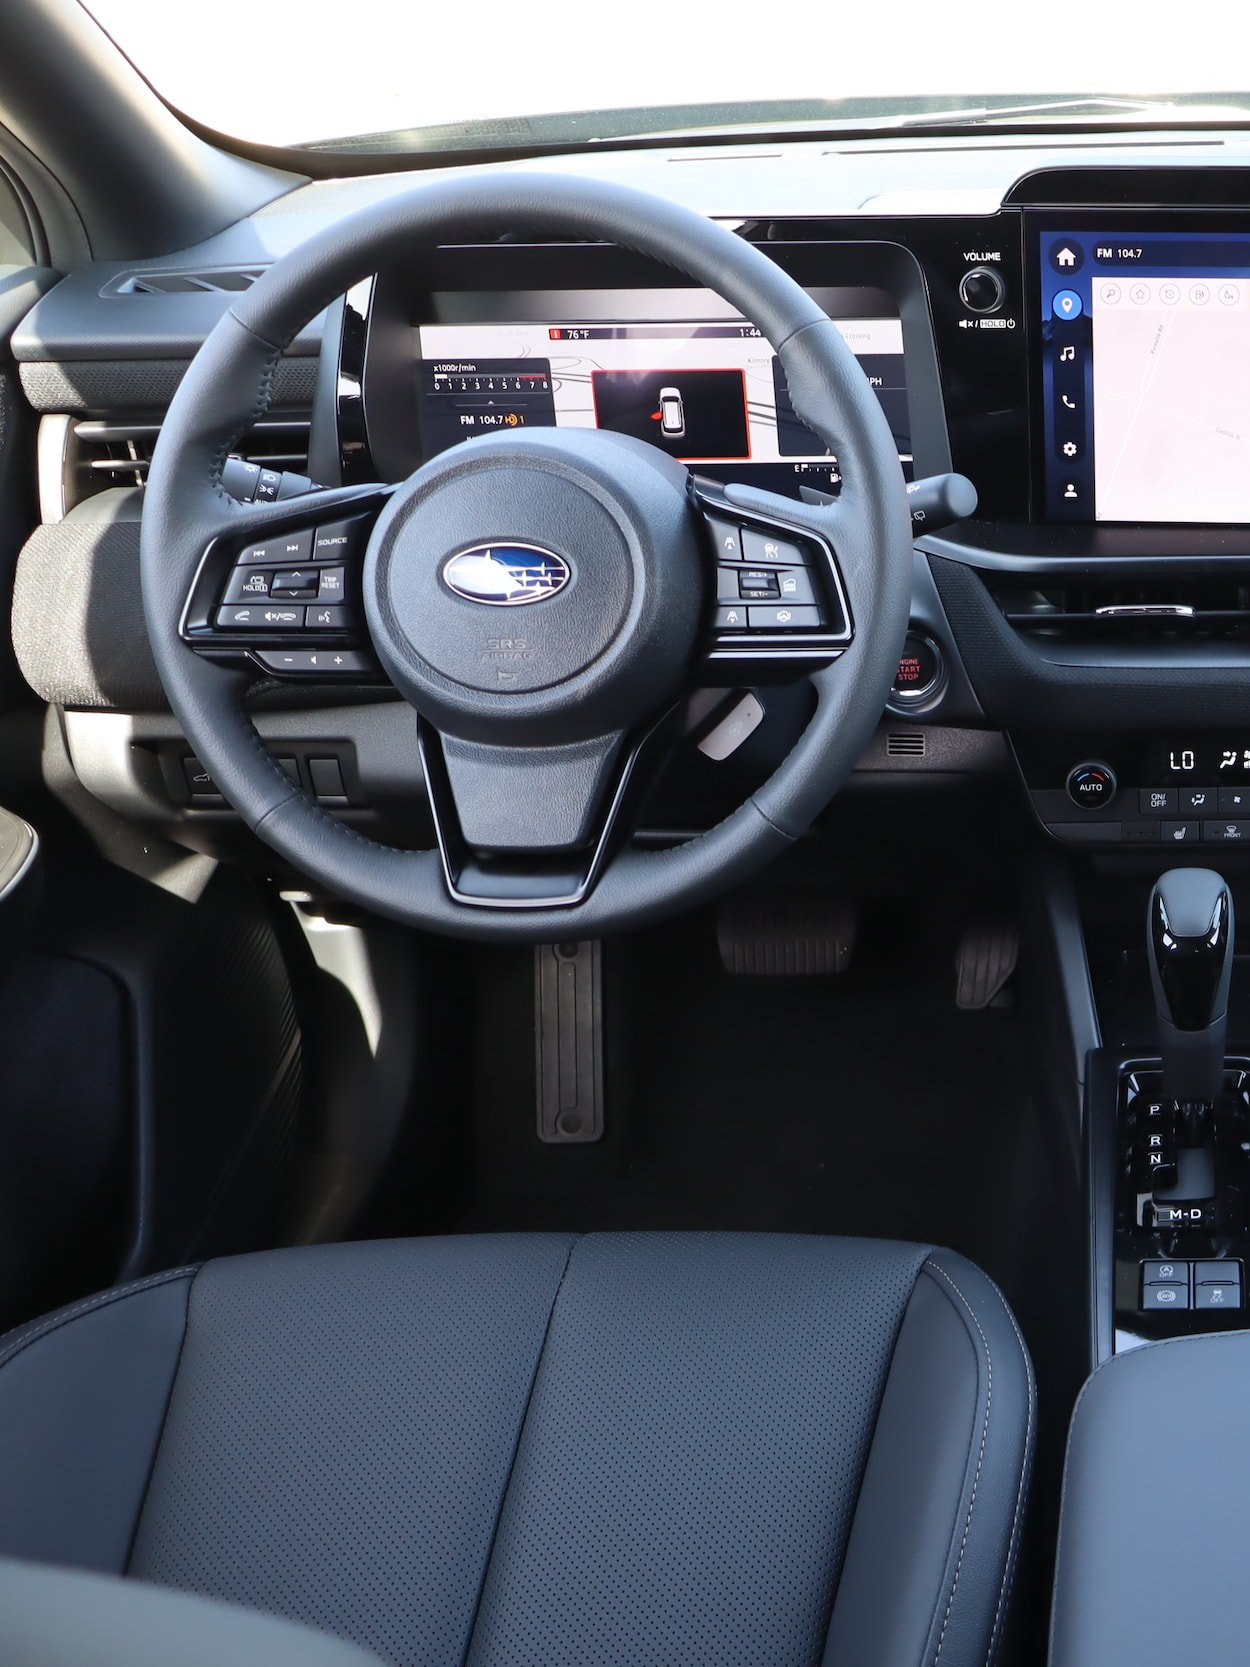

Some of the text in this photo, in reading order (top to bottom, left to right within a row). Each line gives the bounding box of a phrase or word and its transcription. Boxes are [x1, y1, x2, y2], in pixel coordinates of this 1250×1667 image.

[963, 252, 1001, 261] VOLUME
[1097, 248, 1113, 258] FM
[1117, 248, 1142, 258] 104.7
[980, 320, 1006, 328] HOLD
[740, 328, 762, 337] 1:44
[433, 363, 477, 373] x1000r/min
[475, 382, 480, 390] 3
[488, 382, 494, 390] 4
[502, 382, 508, 390] 5
[515, 382, 521, 390] 6
[460, 416, 475, 425] FM
[480, 416, 503, 425] 104.7
[317, 537, 348, 546] SOURCE
[487, 638, 526, 649] SRS
[482, 652, 532, 661] AIRBAG
[1080, 784, 1103, 792] AUTO
[1150, 1105, 1160, 1115] P
[1150, 1136, 1161, 1146] R
[1150, 1154, 1161, 1164] N
